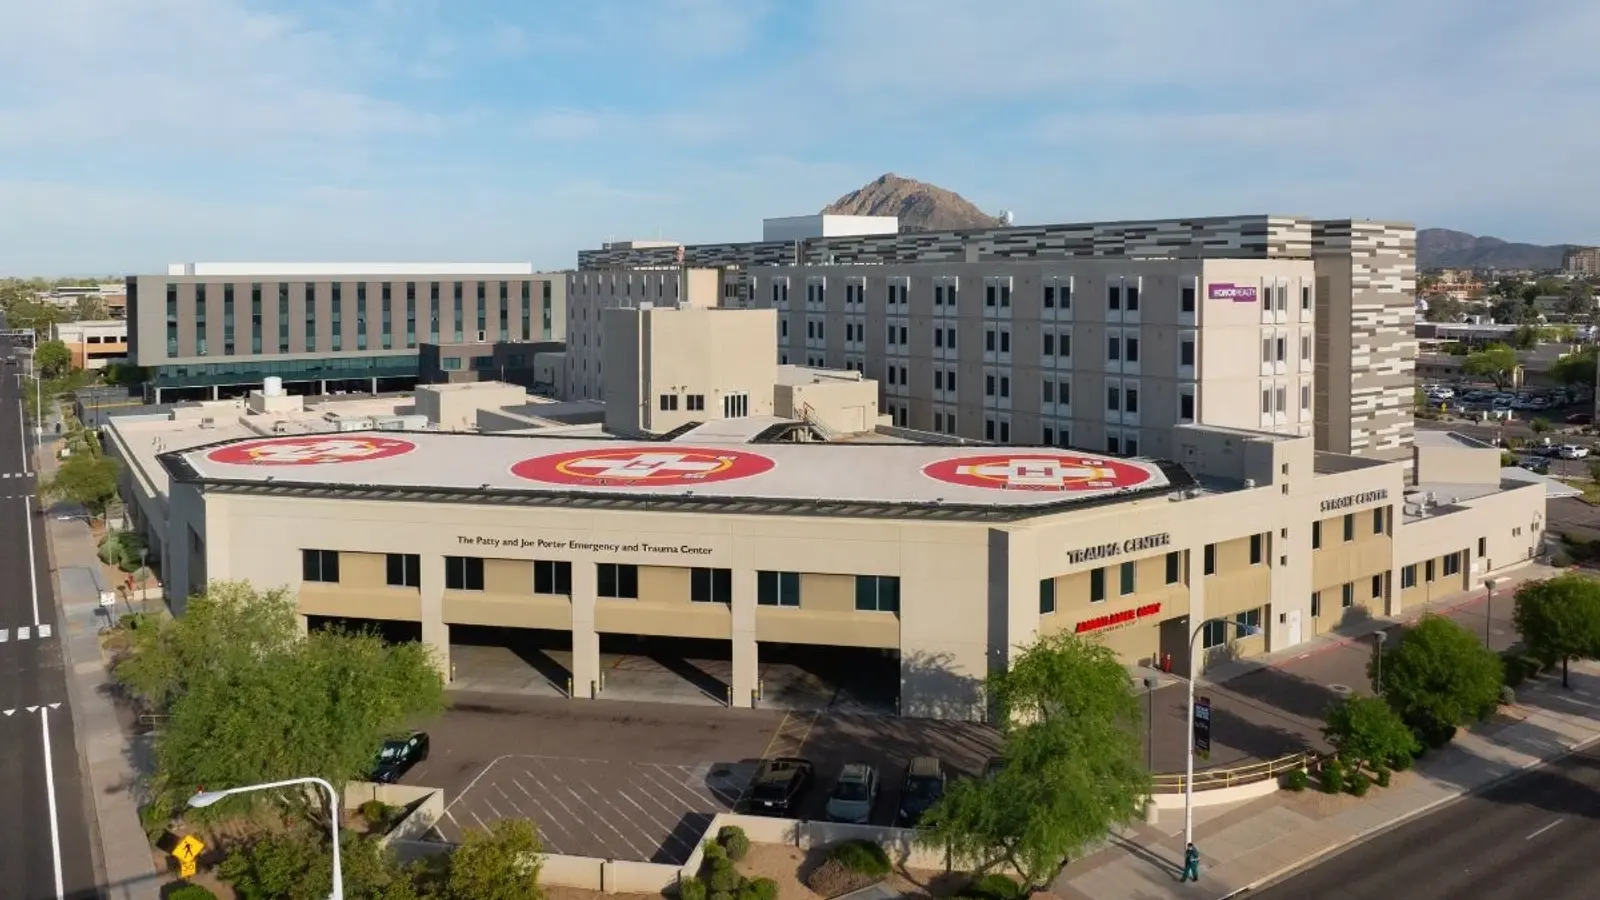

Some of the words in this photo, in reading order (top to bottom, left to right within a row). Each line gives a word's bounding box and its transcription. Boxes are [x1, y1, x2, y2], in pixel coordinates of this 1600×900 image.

[1017, 466, 1053, 476] H
[1320, 495, 1355, 512] STROKE
[1356, 489, 1388, 505] CENTER
[457, 536, 474, 544] The
[476, 536, 500, 547] Patty
[502, 538, 518, 547] and
[521, 538, 535, 548] Joe
[538, 539, 566, 548] Porter
[569, 540, 620, 553] Emergency
[622, 543, 639, 552] and
[642, 543, 679, 553] Trauma
[680, 545, 713, 555] Center
[1067, 542, 1121, 564] TRAUMA
[1123, 532, 1170, 553] CENTER
